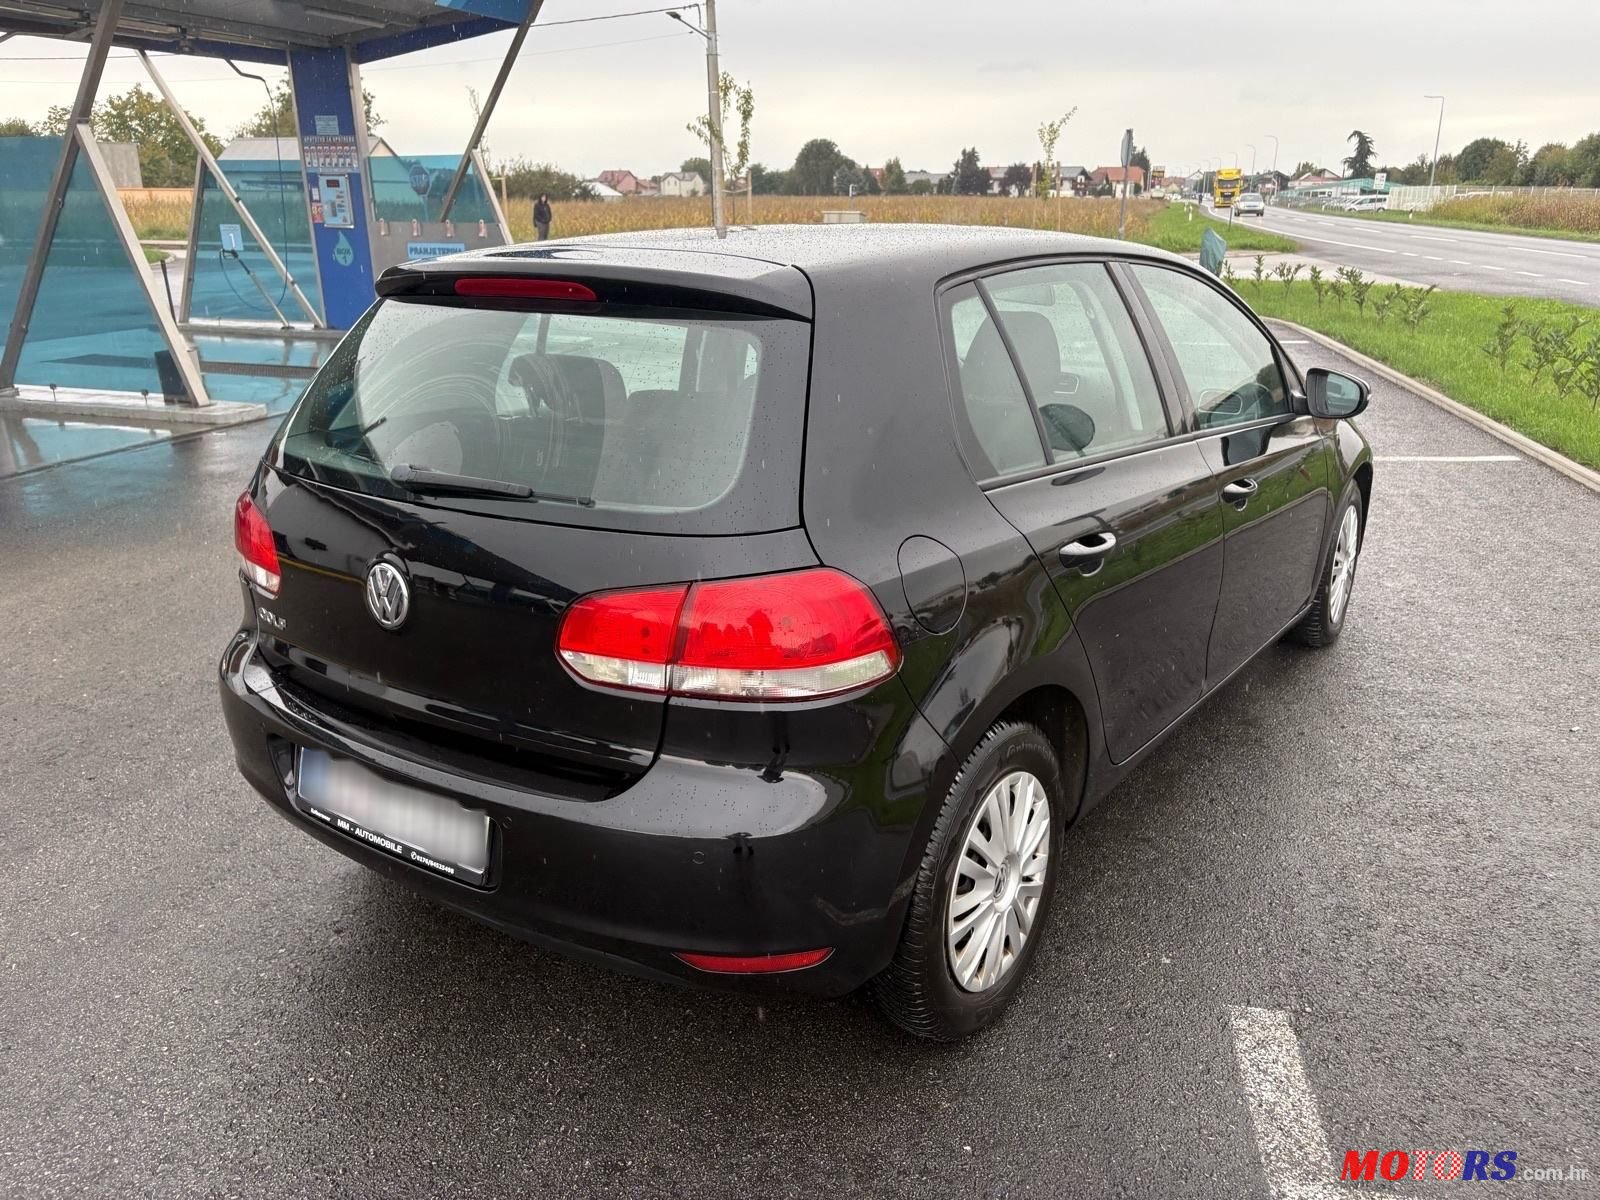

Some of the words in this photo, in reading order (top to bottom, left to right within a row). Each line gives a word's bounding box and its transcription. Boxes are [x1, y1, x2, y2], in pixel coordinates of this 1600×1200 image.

[229, 233, 235, 248] 1
[258, 607, 287, 631] GOLF
[337, 818, 350, 831] MM
[354, 827, 403, 854] AUTOMOBILE
